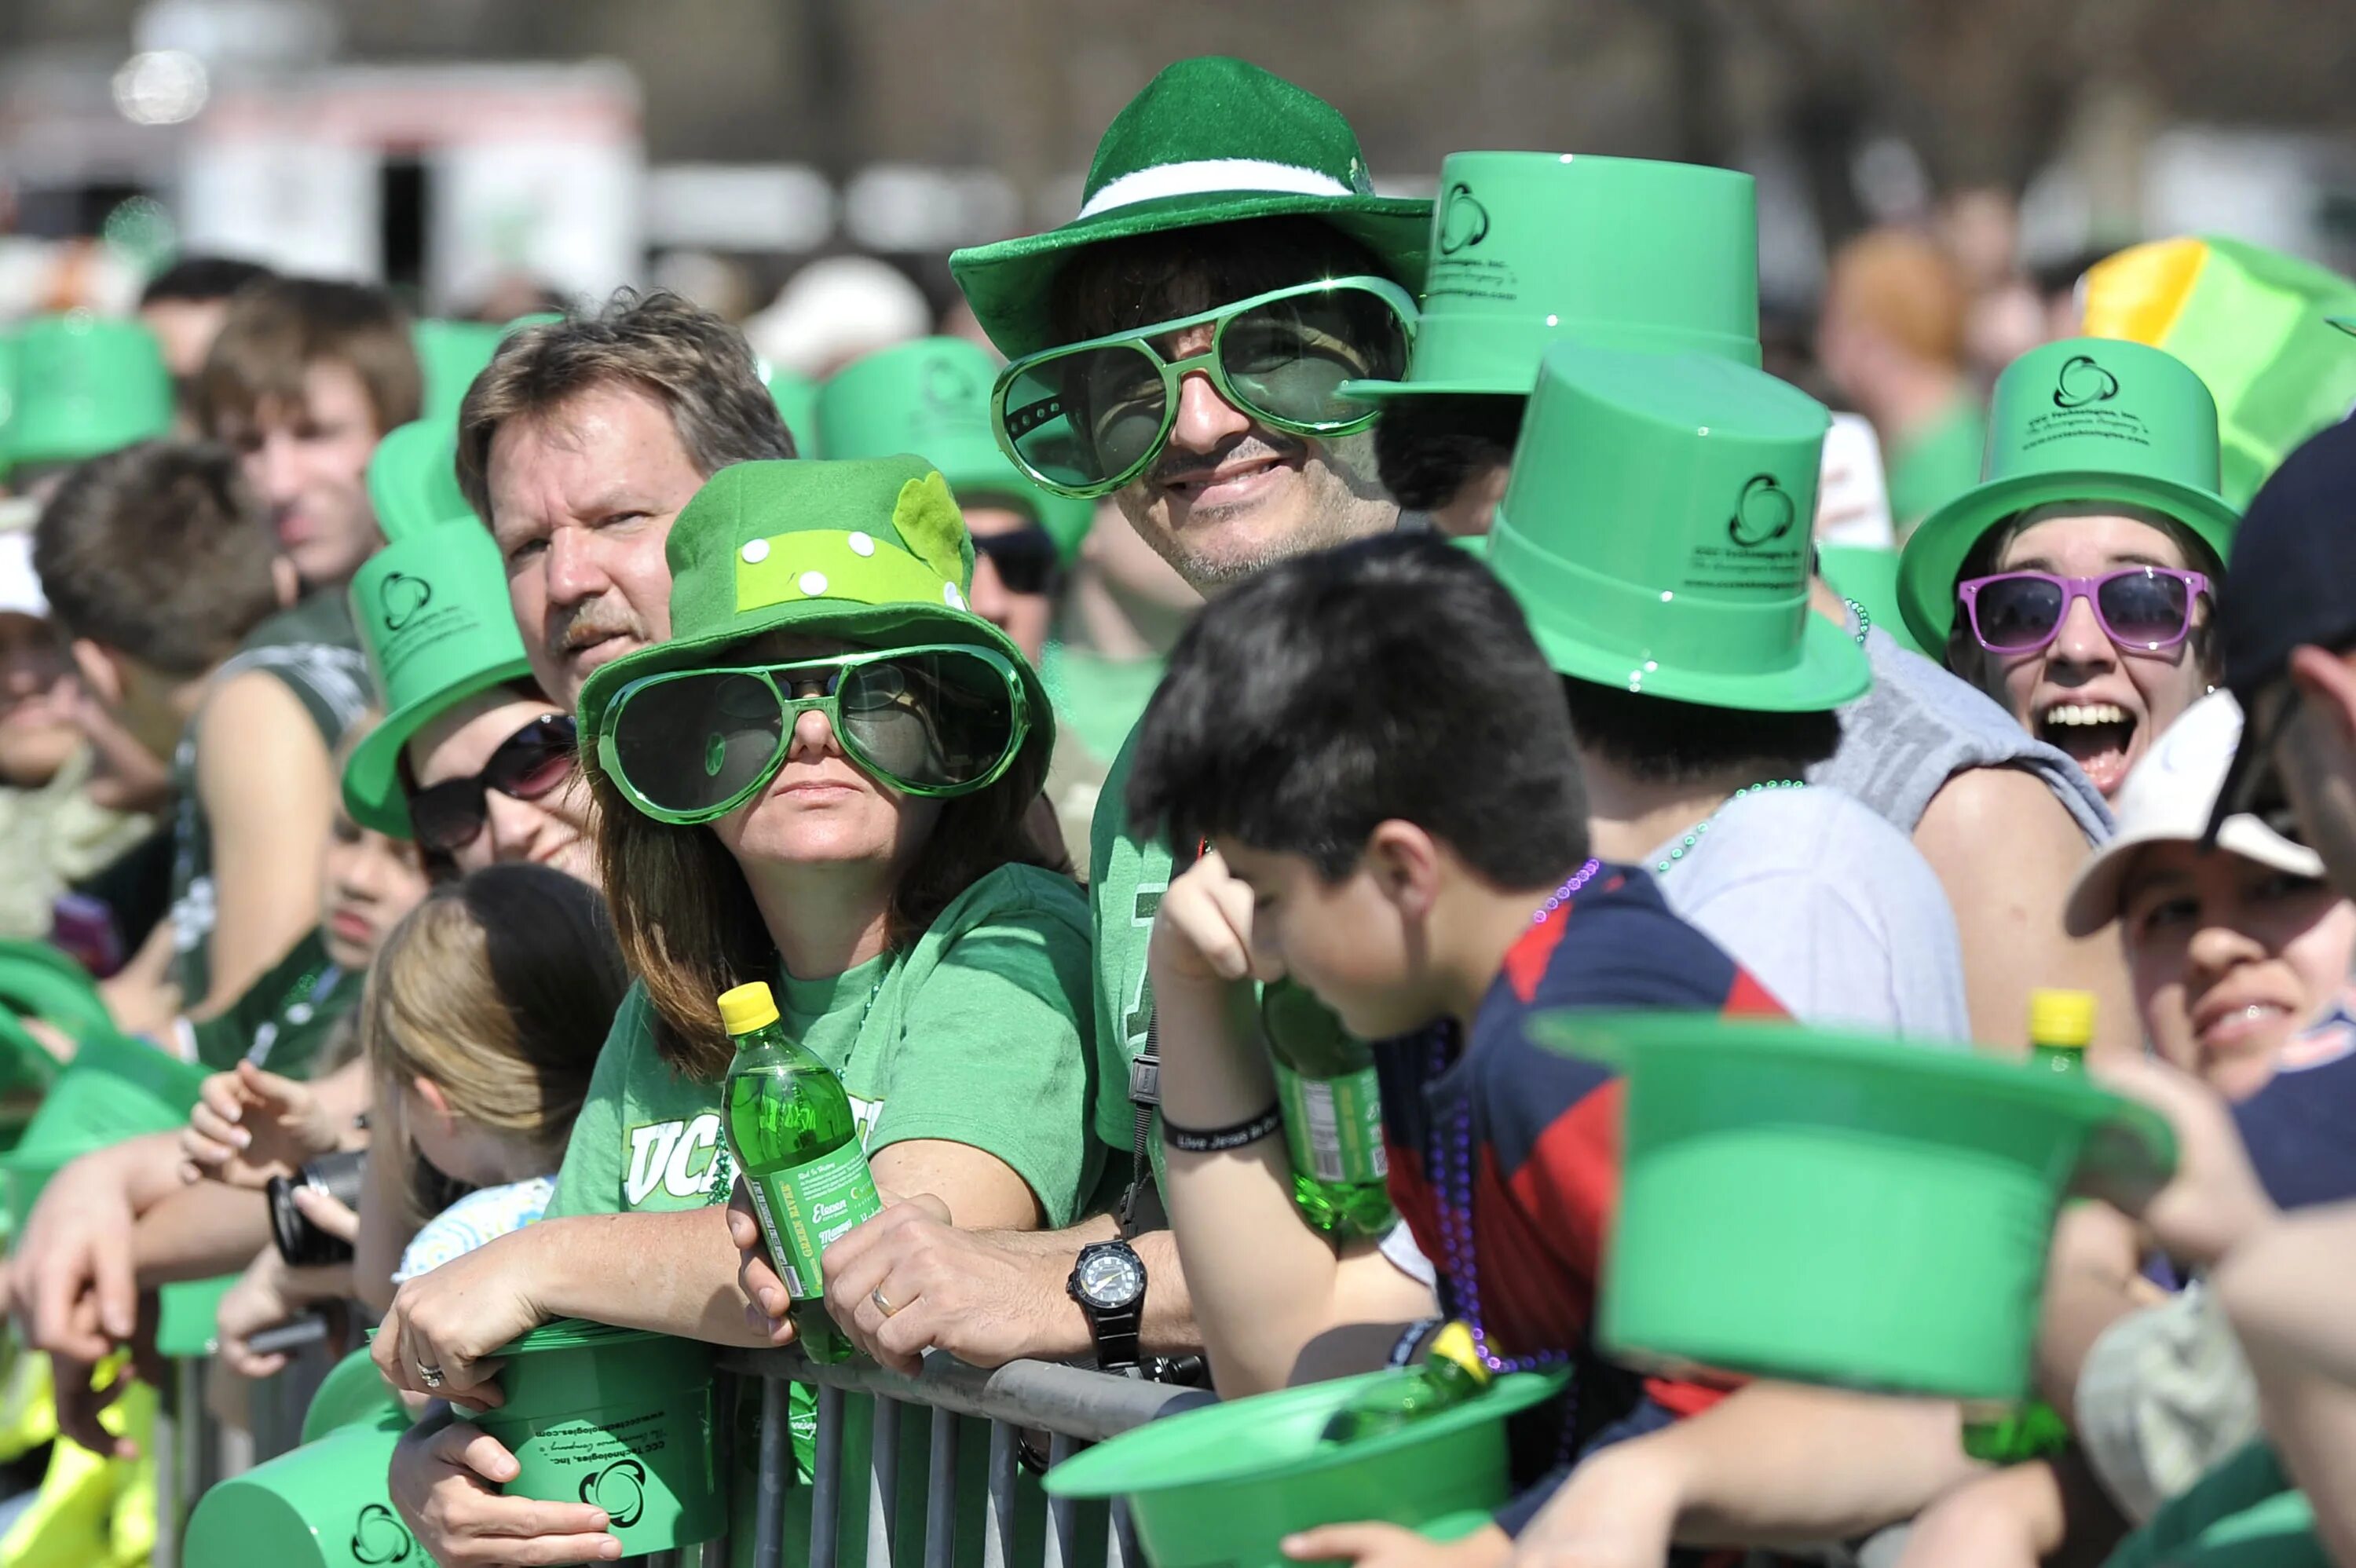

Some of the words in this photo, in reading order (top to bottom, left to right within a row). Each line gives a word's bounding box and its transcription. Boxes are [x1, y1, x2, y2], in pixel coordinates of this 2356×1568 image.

[536, 1410, 666, 1438] www.ccctechnologies.com
[645, 1440, 665, 1453] CCC
[550, 1457, 571, 1466] Inc.
